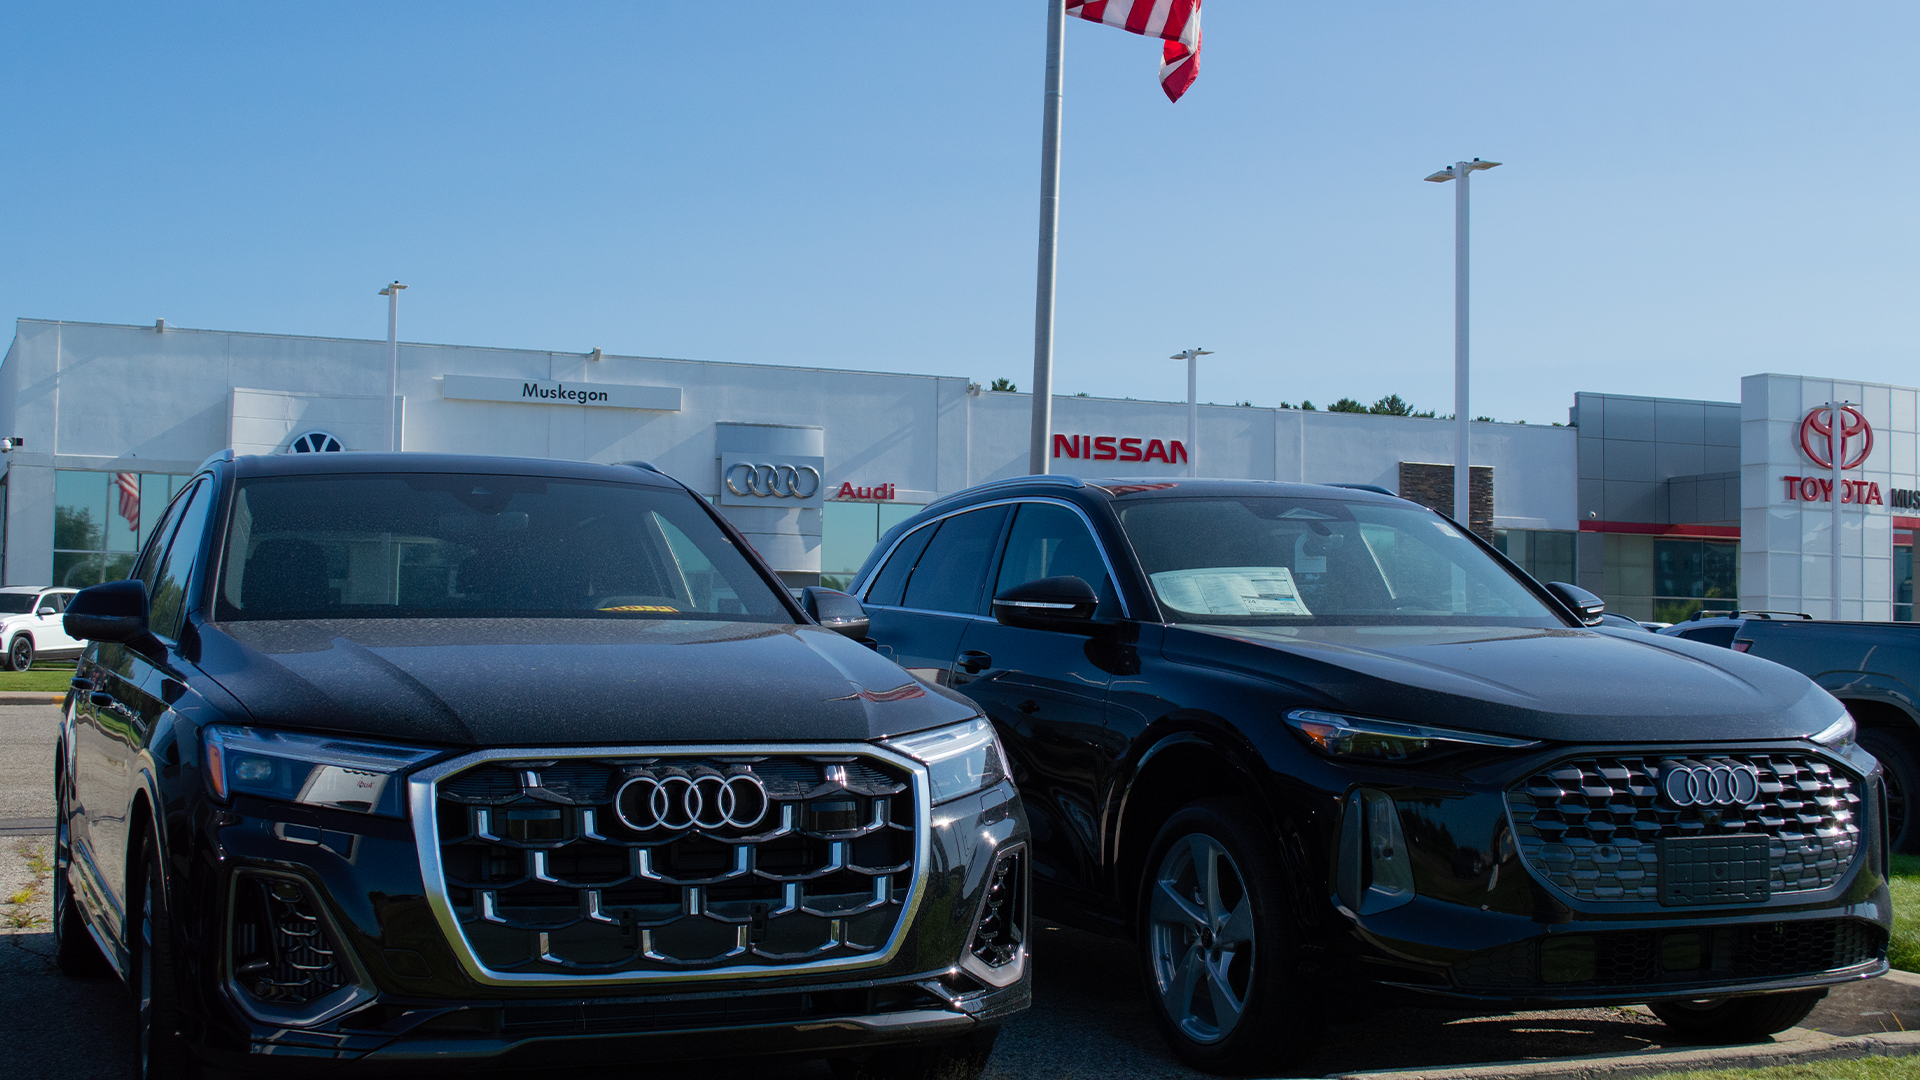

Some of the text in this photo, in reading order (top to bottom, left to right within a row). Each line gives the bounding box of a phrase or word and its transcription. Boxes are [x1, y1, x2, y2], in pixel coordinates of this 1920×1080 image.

[522, 383, 608, 404] Muskegon
[1054, 434, 1187, 464] NISSAN
[838, 482, 894, 500] Audi
[1784, 476, 1883, 505] TOYOTA
